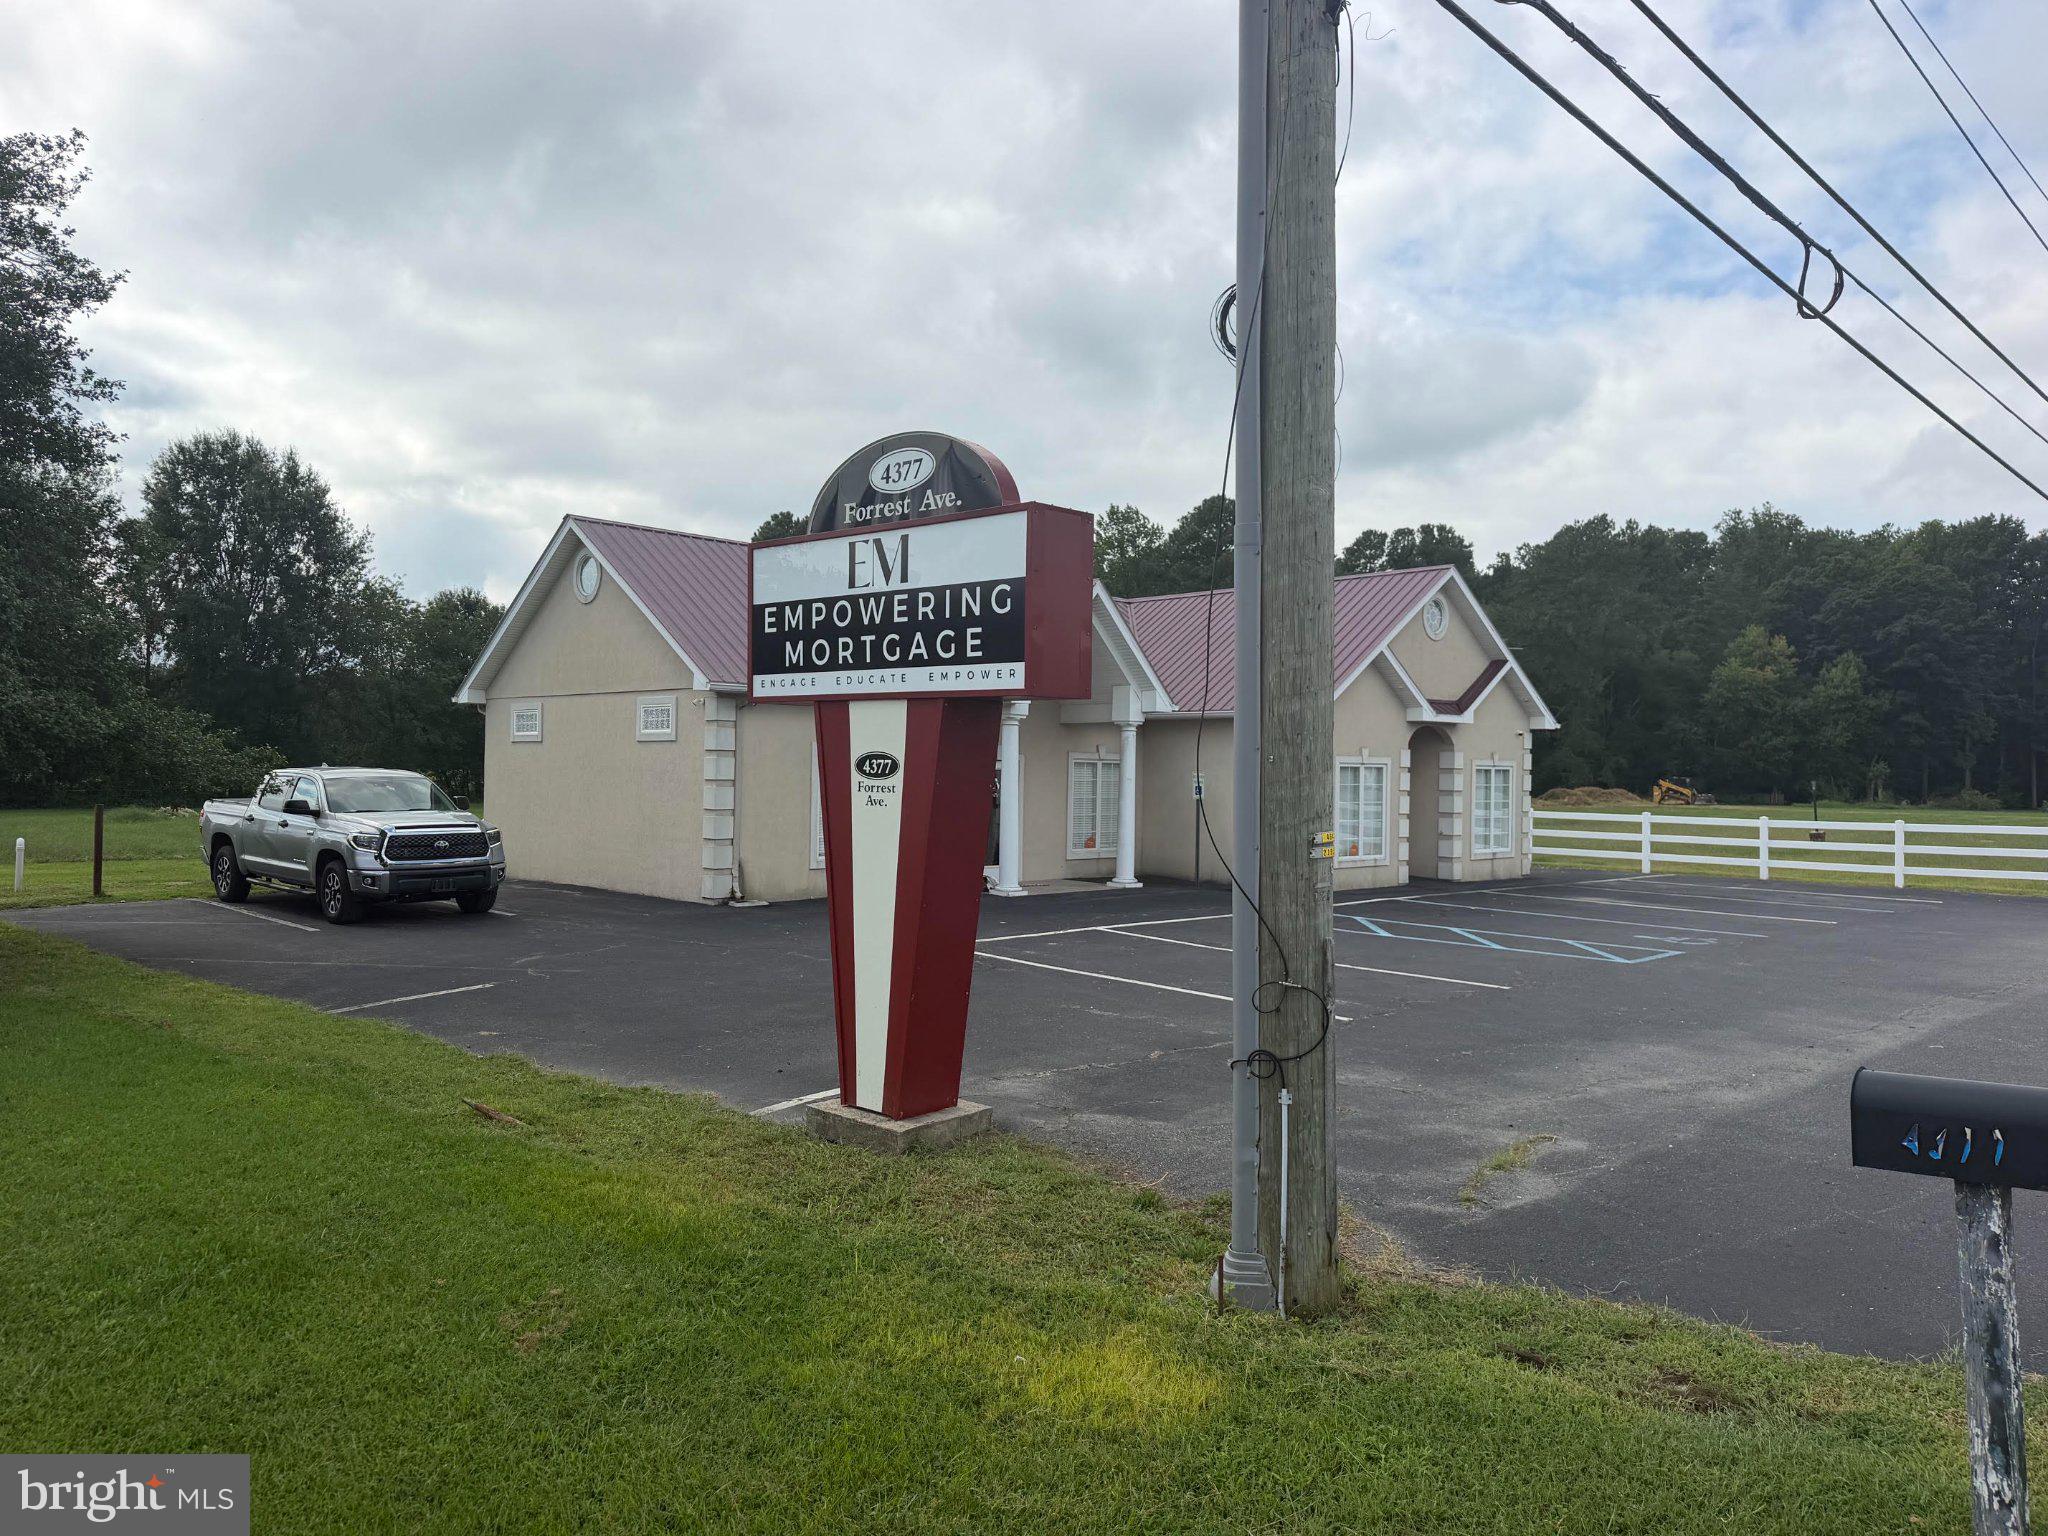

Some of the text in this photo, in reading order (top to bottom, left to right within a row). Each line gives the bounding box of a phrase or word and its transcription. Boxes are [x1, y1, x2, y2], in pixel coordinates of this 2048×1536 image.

[881, 458, 924, 485] 4377
[843, 489, 962, 524] Forrest Ave.
[847, 533, 910, 590] EM
[763, 583, 1012, 634] EMPOWERING
[784, 626, 983, 668] MORTGAGE
[760, 668, 1016, 689] ENGAGE EDUCATE EMPOWER
[862, 758, 892, 774] 4377
[857, 781, 897, 794] Forrest
[864, 794, 888, 807] Ave.
